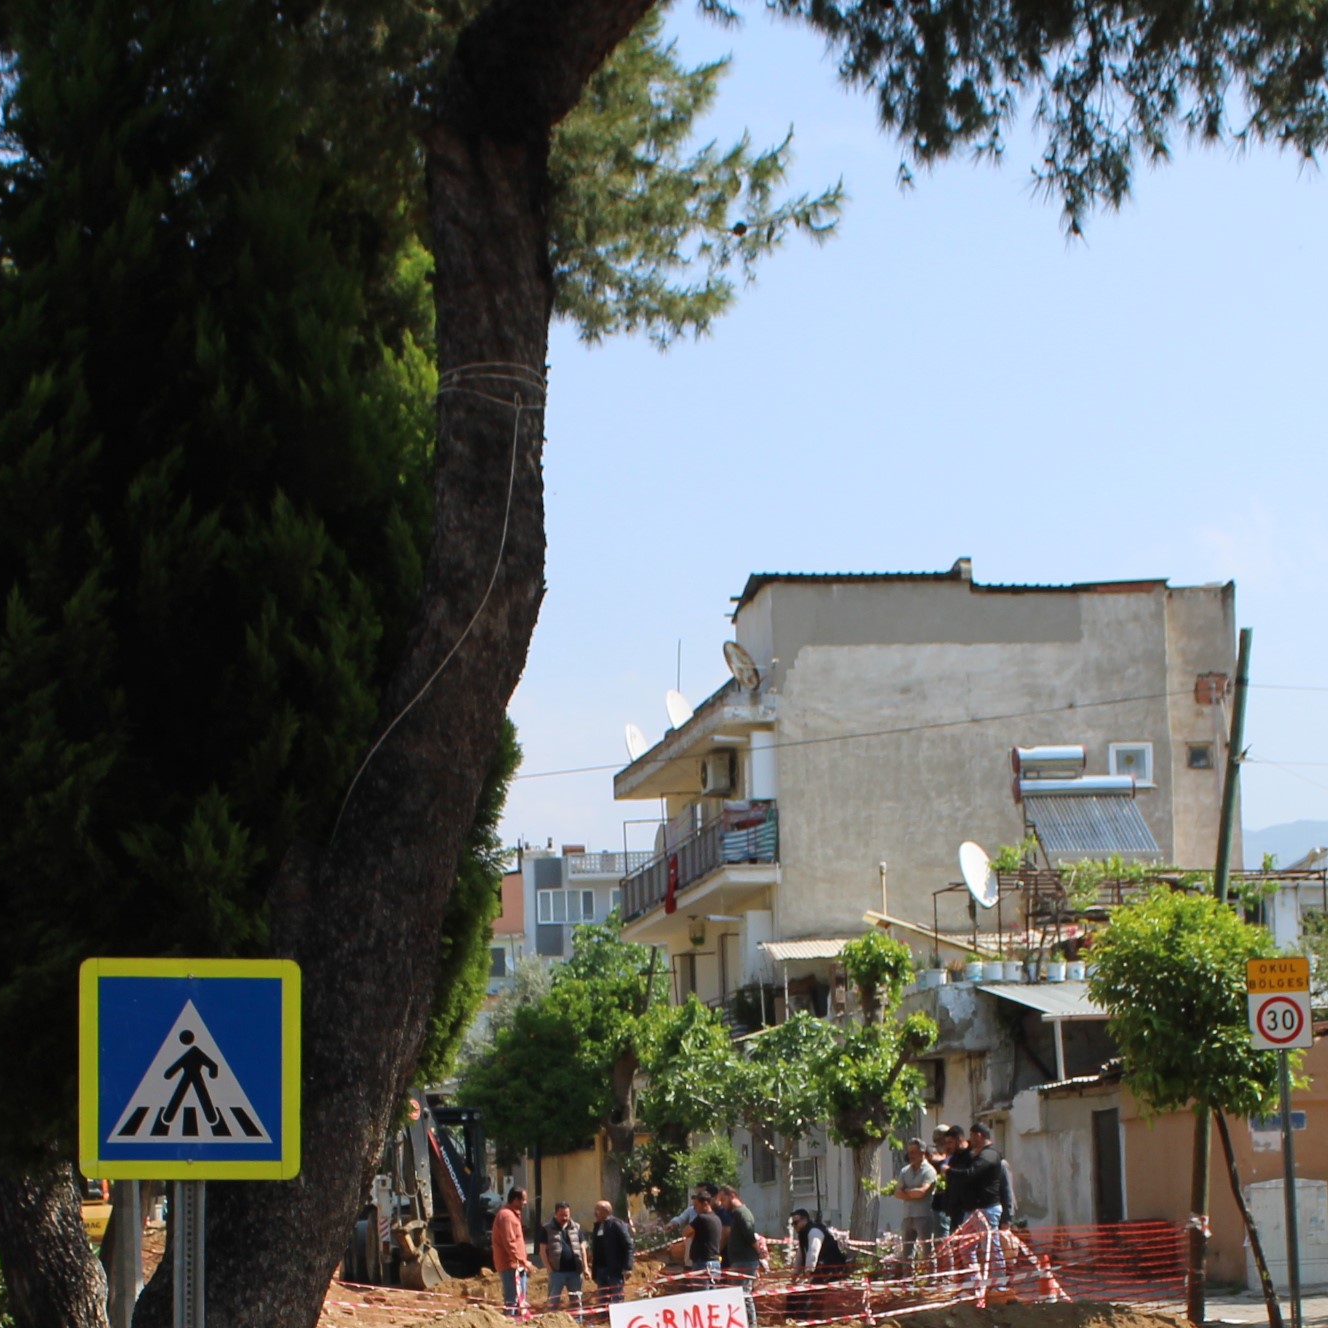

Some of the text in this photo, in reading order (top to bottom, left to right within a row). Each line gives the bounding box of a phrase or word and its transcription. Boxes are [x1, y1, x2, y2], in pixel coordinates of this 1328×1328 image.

[1259, 963, 1297, 974] OKUL
[1249, 976, 1310, 990] BÖLGESİ
[1267, 1008, 1294, 1031] 30
